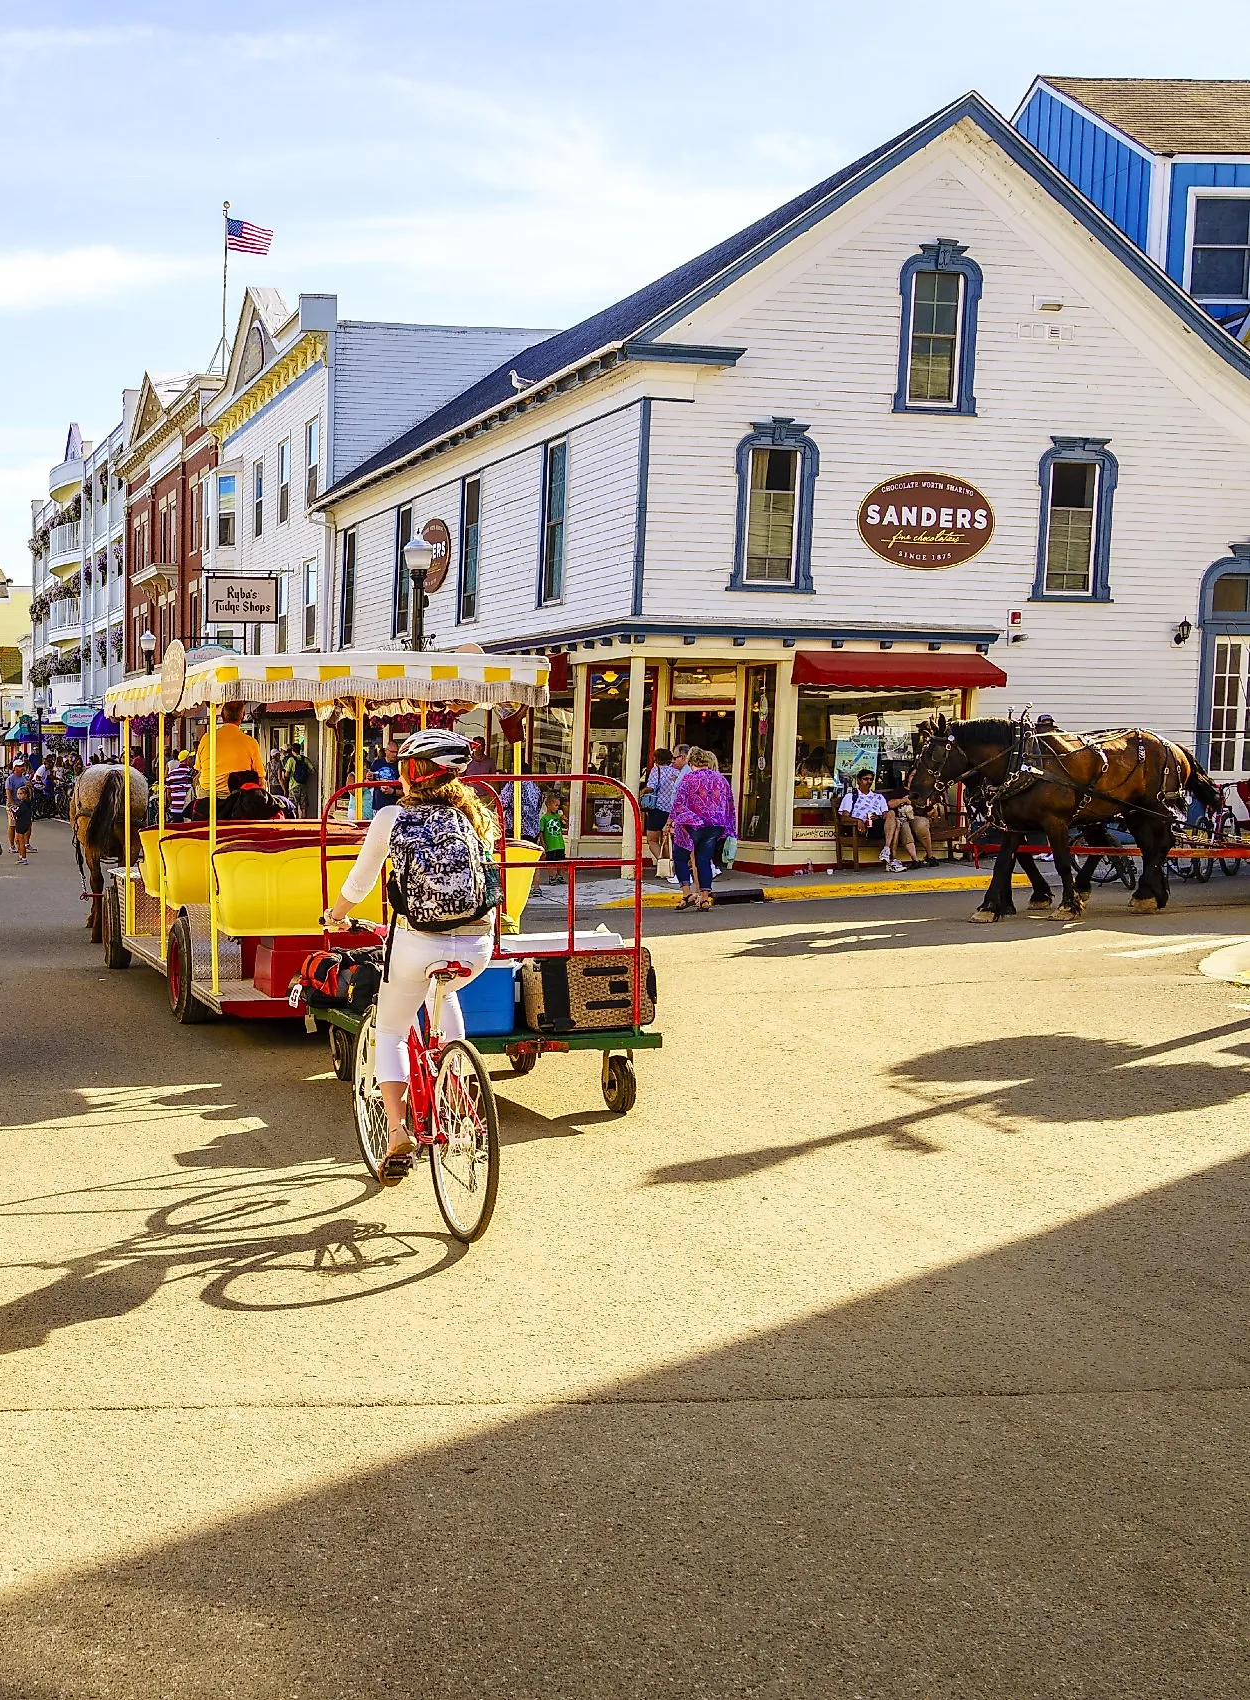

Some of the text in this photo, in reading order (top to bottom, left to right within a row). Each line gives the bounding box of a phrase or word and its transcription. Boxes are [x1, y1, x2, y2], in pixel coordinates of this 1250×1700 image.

[881, 481, 974, 497] CHOCOLATE WORTH SHARING
[866, 504, 988, 530] SANDERS
[887, 530, 911, 549] fine
[898, 550, 927, 561] SINCE
[226, 585, 258, 603] Ryba's
[242, 600, 272, 615] Shops
